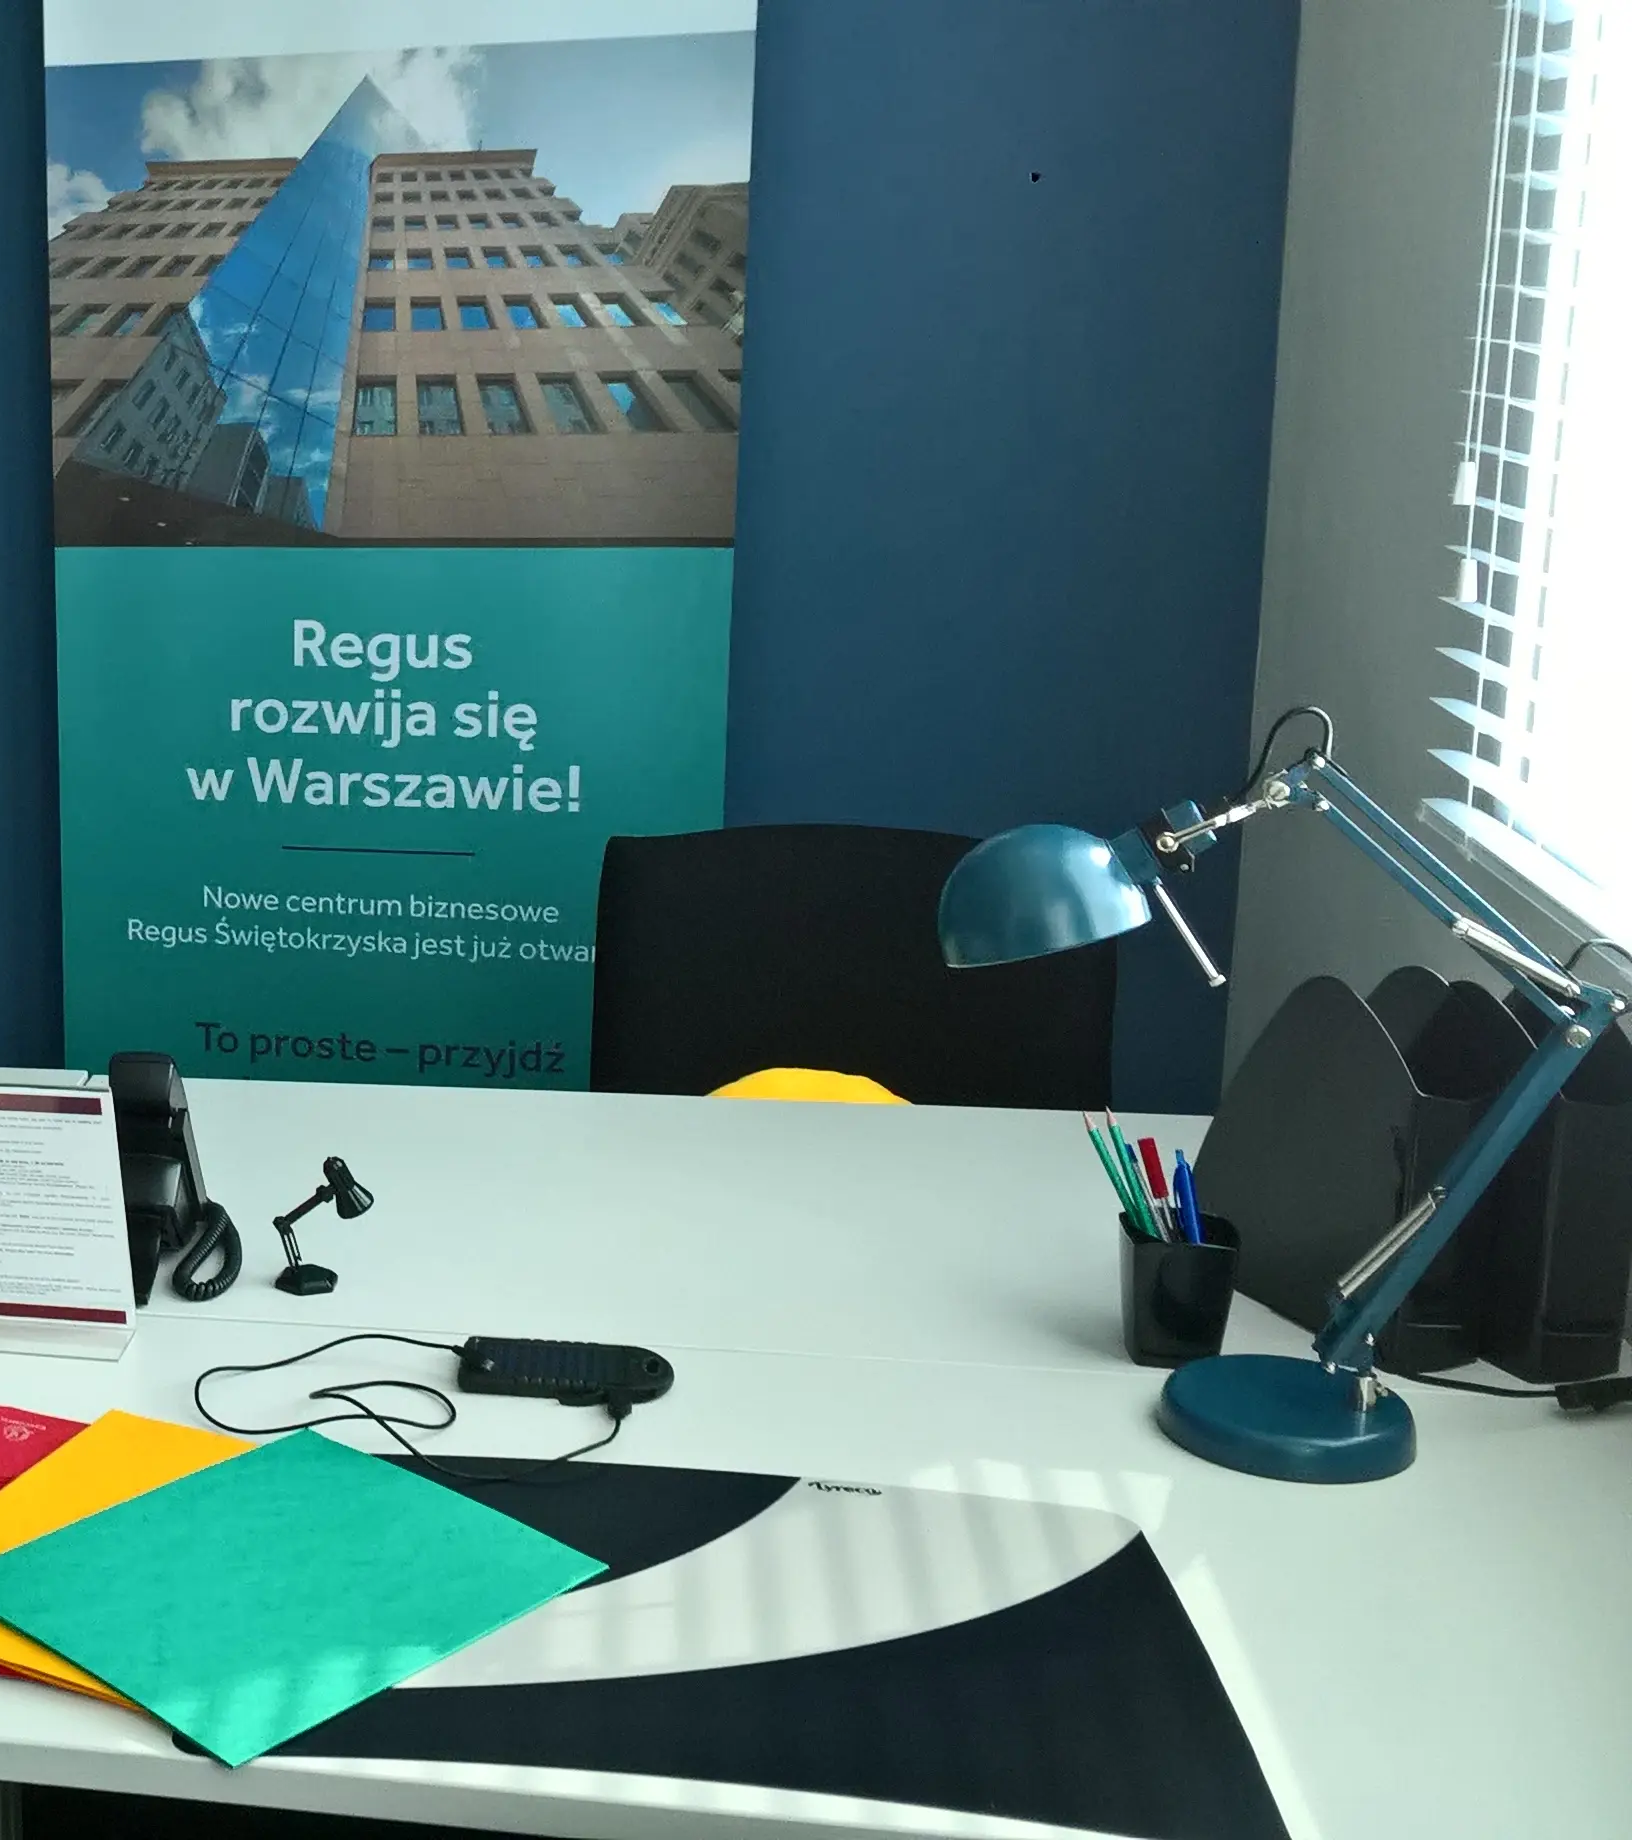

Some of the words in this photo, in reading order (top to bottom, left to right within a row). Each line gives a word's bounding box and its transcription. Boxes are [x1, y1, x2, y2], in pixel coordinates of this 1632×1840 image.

[293, 619, 473, 682] Regus
[230, 688, 436, 748] rozwija
[453, 690, 538, 751] się
[185, 768, 235, 802] w
[247, 757, 581, 813] Warszawie!
[203, 885, 279, 912] Nowe
[286, 892, 402, 917] centrum
[410, 894, 560, 924] biznesowe
[127, 918, 207, 947] Regus
[214, 917, 407, 957] Świętokrzyska
[411, 931, 466, 960] jest
[469, 935, 512, 963] już
[196, 1021, 239, 1054] To
[250, 1032, 377, 1063] proste
[418, 1039, 566, 1079] przyjdź
